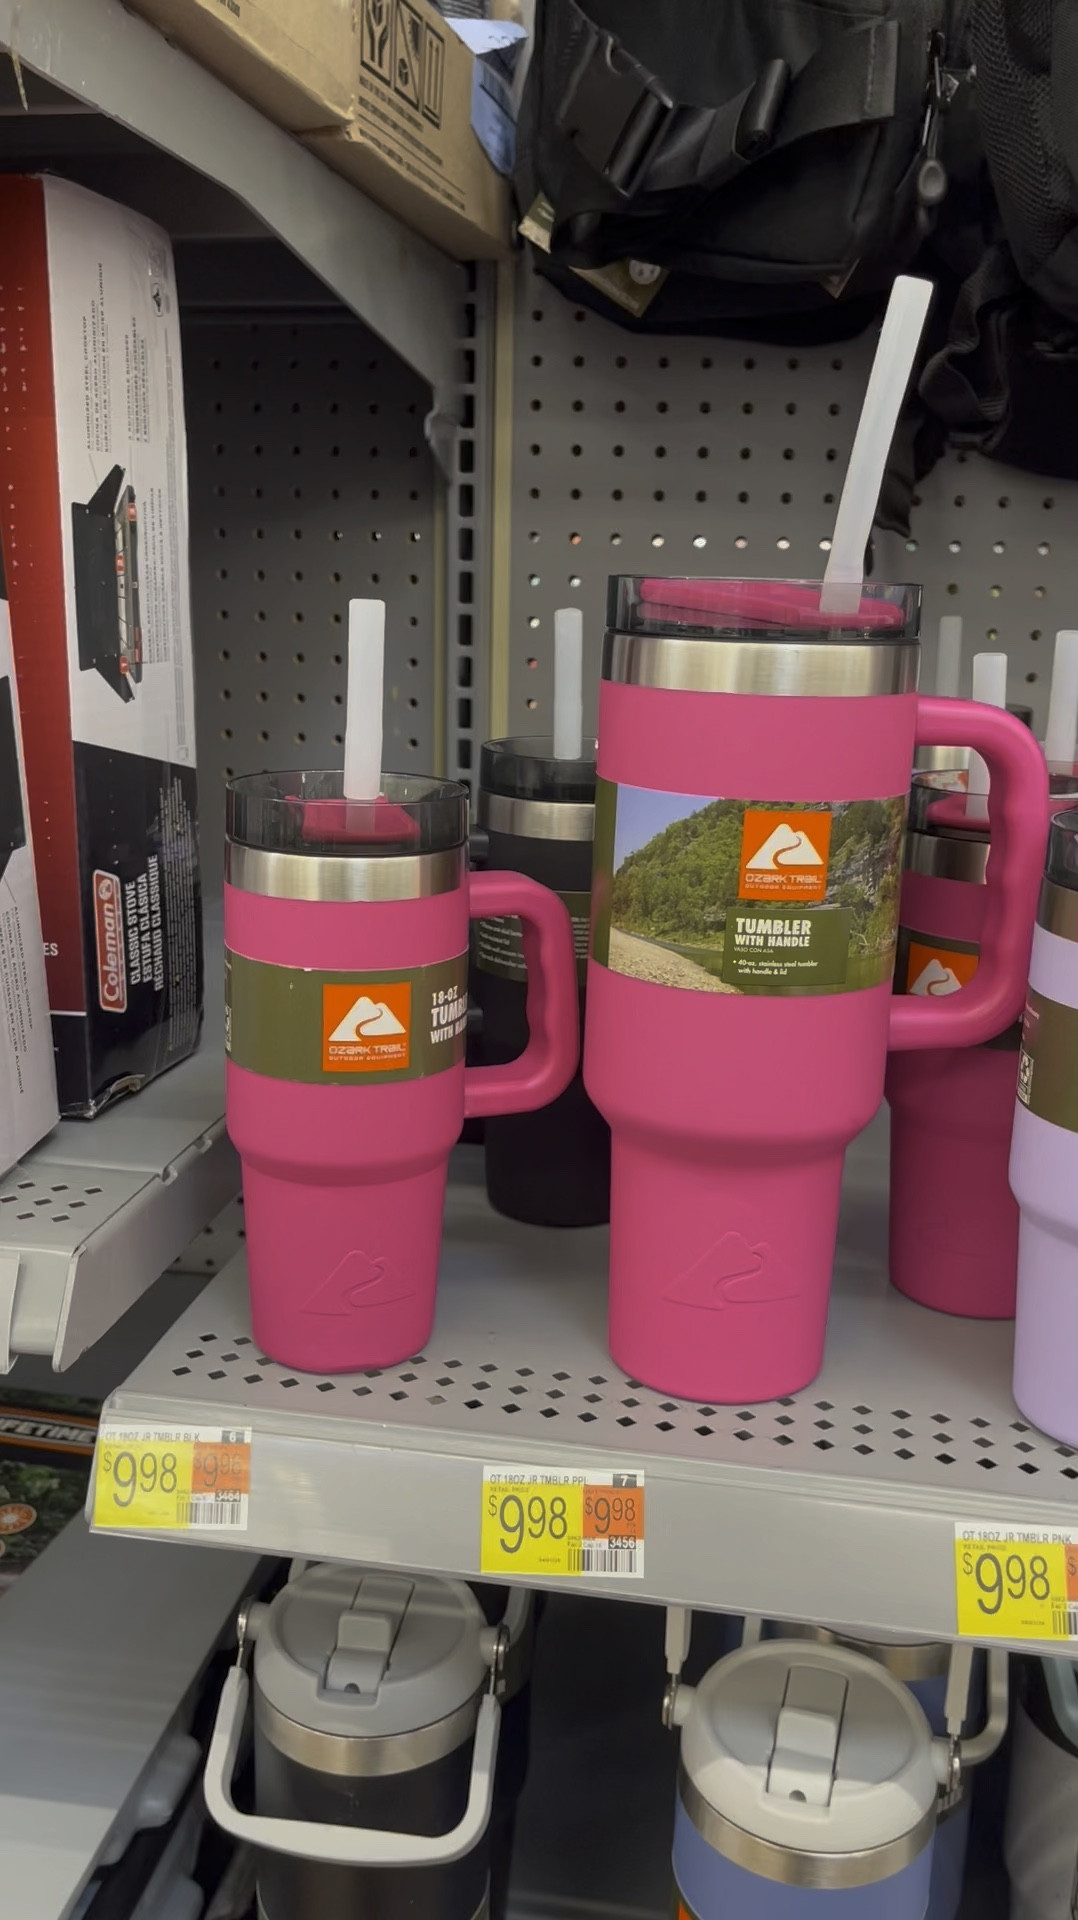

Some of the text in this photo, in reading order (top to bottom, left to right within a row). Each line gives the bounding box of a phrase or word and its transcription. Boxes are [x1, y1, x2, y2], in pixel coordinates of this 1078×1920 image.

[745, 873, 822, 884] OZARK TRAIL
[136, 872, 153, 983] ESTUFA CLÁSICA
[147, 854, 165, 992] RÉCHAUD CLASSIQUE
[736, 918, 812, 935] TUMBLER
[125, 880, 142, 984] CLASSIC STOVE
[734, 934, 810, 948] WITH HANDLE
[102, 903, 121, 1002] Coleman
[784, 960, 796, 968] steel
[780, 968, 788, 976] lid
[430, 1024, 454, 1044] WITH
[328, 1042, 405, 1055] OZARK TRAIL
[140, 1432, 152, 1442] JR
[154, 1432, 181, 1442] TMBLR
[490, 1474, 502, 1484] OT
[528, 1476, 538, 1485] JR
[540, 1476, 570, 1486] TMBLR
[620, 1475, 628, 1486] 7
[609, 1536, 636, 1548] 3456
[962, 1530, 976, 1541] OT
[1004, 1532, 1014, 1542] JR
[1016, 1532, 1050, 1544] TMBLR
[1052, 1534, 1072, 1544] PNK
